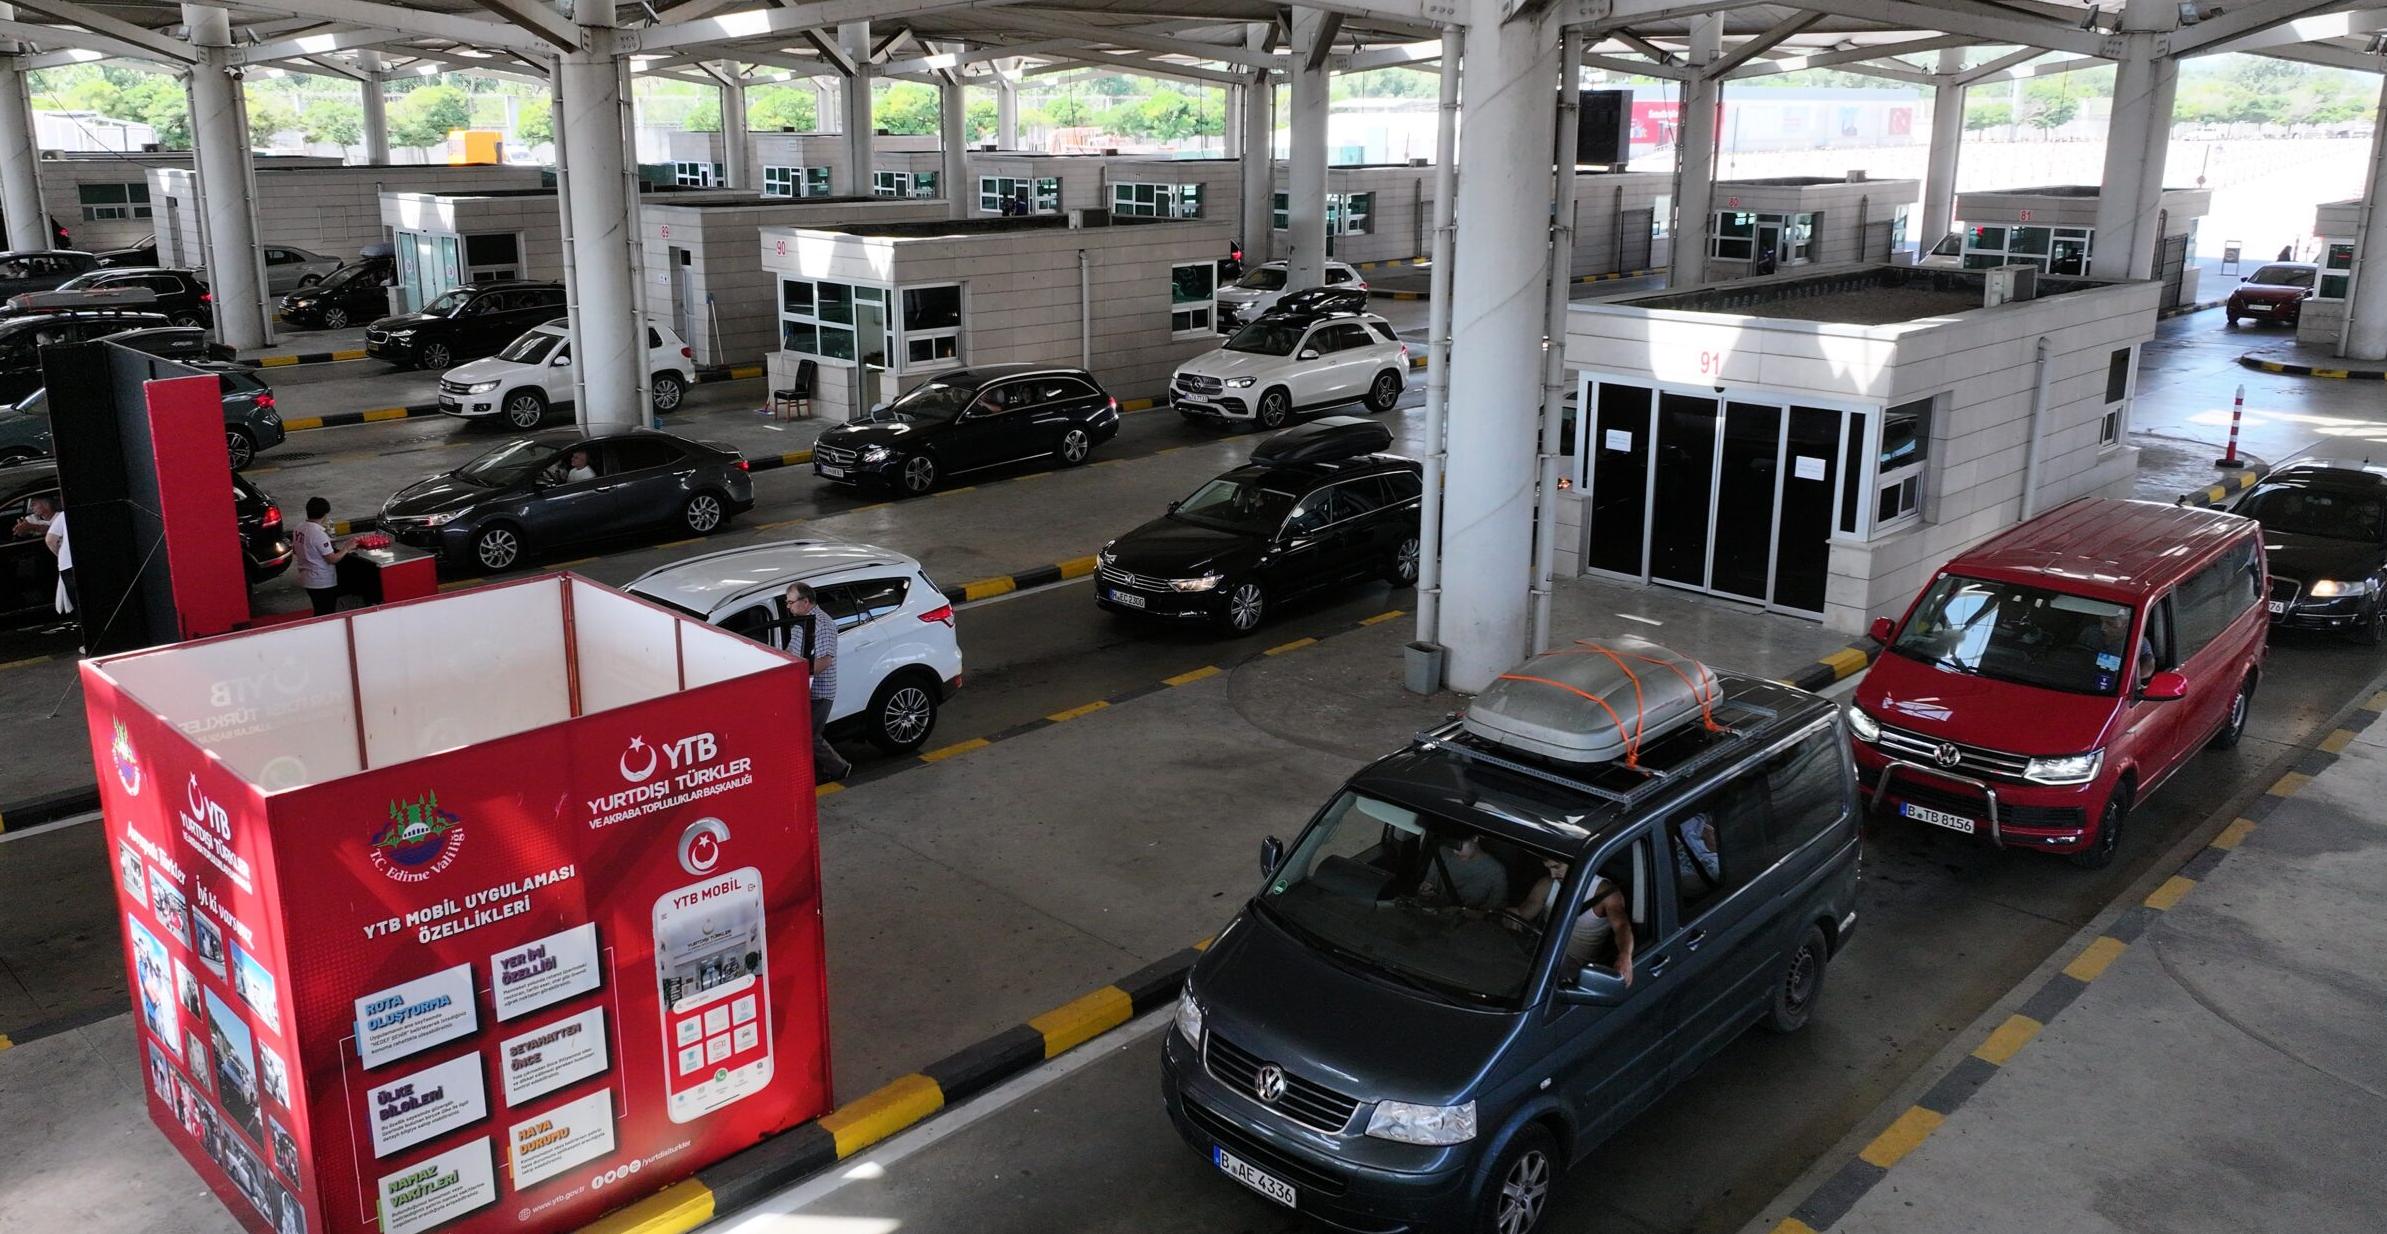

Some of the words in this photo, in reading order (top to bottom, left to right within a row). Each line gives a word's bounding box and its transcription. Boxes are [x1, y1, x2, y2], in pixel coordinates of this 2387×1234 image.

[2020, 210, 2031, 221] 81
[776, 240, 786, 256] 90
[1700, 351, 1720, 375] 91
[662, 732, 717, 770] YTB
[587, 780, 670, 815] YURTDIŞI
[675, 757, 751, 790] TÜRKLER
[589, 817, 602, 830] VE
[603, 806, 641, 827] AKRABA
[641, 788, 703, 816] TOPLULUKLAR
[704, 775, 752, 799] BAŞKANLIĞI
[203, 796, 231, 840] YTB
[1907, 805, 1916, 817] B
[1924, 810, 1939, 823] TB
[1941, 815, 1972, 832] 8156
[370, 848, 384, 872] T.C.
[386, 866, 431, 883] Edirne
[432, 828, 465, 874] Valiliği
[363, 918, 402, 940] YTB
[406, 898, 461, 928] MOBİL
[465, 863, 576, 909] UYGULAMASI
[673, 893, 698, 910] YTB
[702, 877, 742, 901] MOBİL
[418, 894, 532, 945] ÖZELLİKLERİ
[501, 954, 527, 970] YER
[502, 956, 557, 986] ÖZELLİĞİ
[365, 994, 404, 1016] ROTA
[367, 994, 452, 1031] OLUŞTURMA
[509, 1023, 582, 1057] SEYAHATTEN
[511, 1053, 543, 1071] ÖNCE
[378, 1083, 414, 1105] ÜLKE
[380, 1085, 444, 1120] BİLGİLERİ
[518, 1120, 553, 1141] HAVA
[520, 1127, 571, 1156] DURUMU
[388, 1165, 438, 1194] NAMAZ
[390, 1170, 459, 1208] VAKİTLERİ
[1221, 1151, 1230, 1169] B
[1238, 1163, 1256, 1185] AE
[1258, 1175, 1293, 1204] 4336
